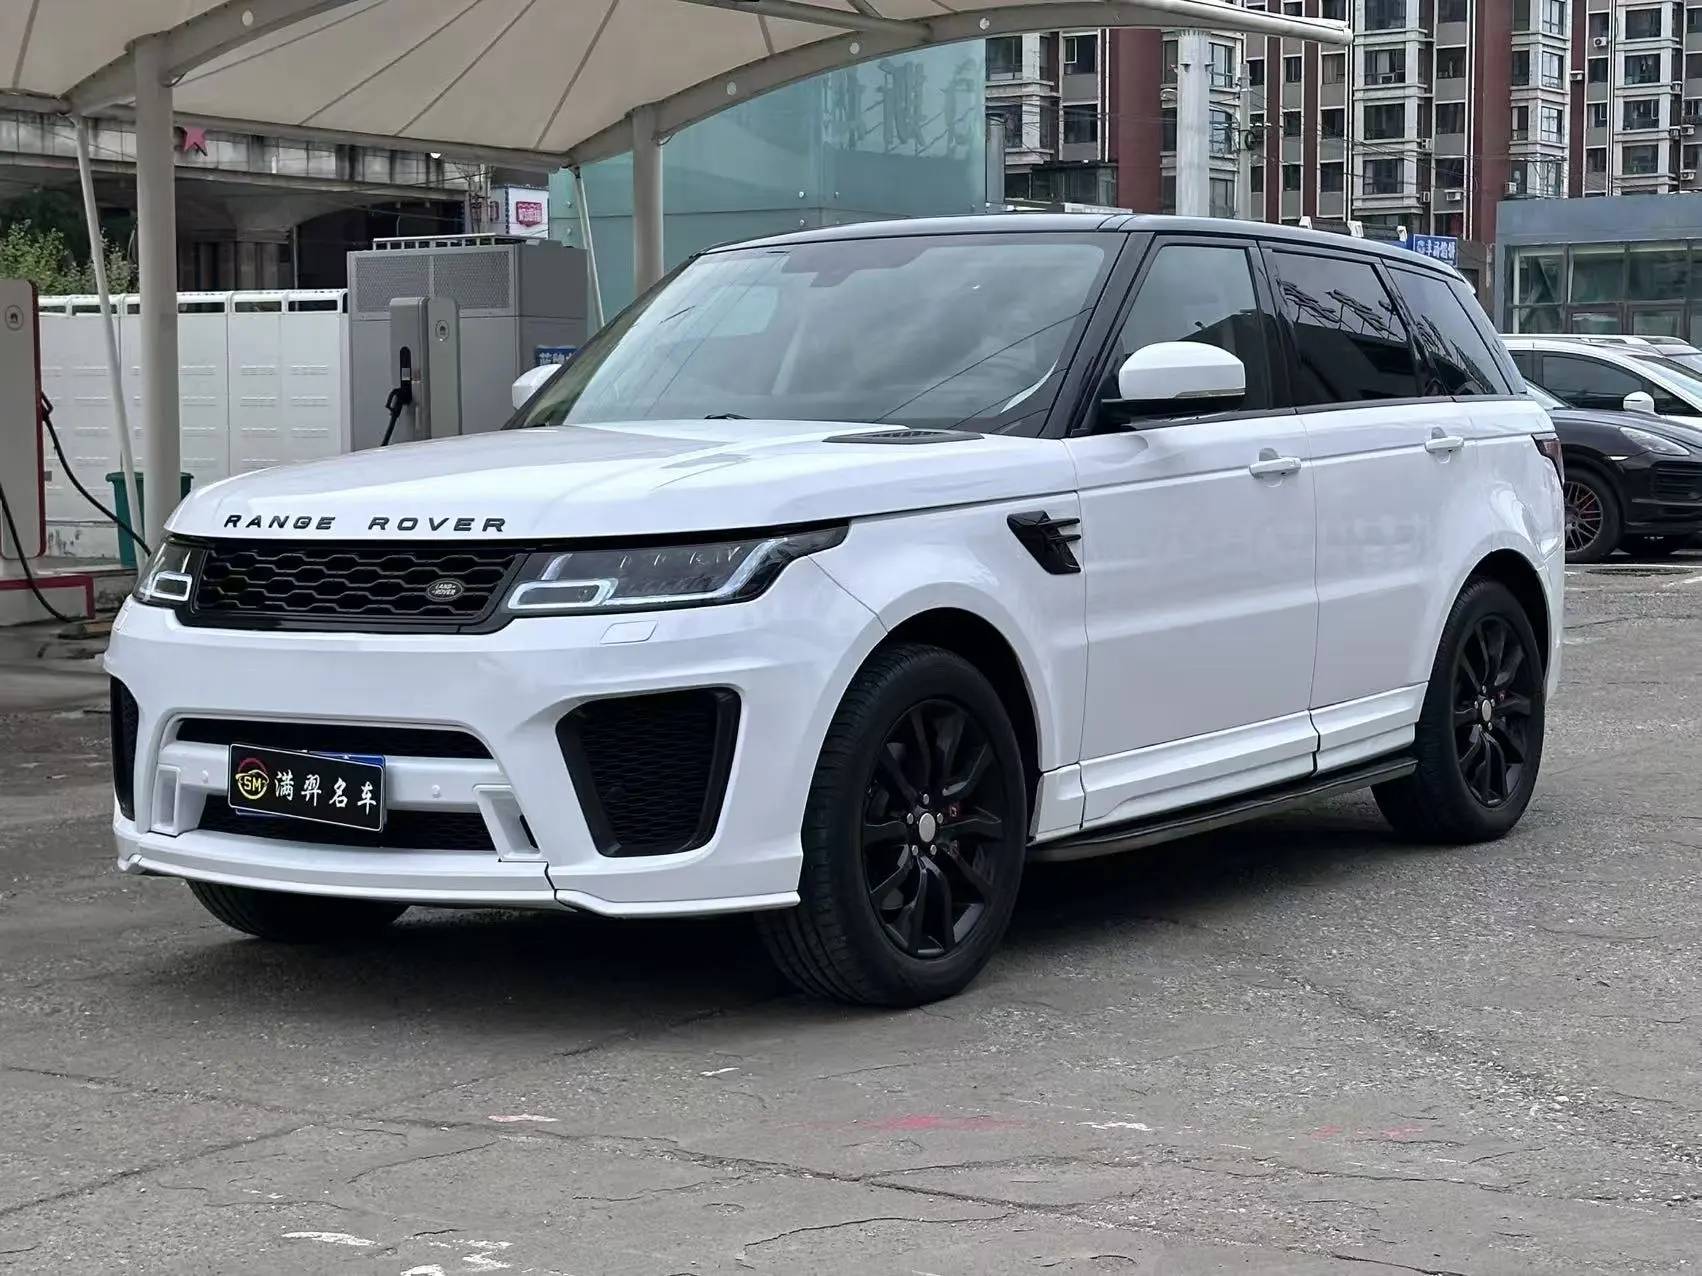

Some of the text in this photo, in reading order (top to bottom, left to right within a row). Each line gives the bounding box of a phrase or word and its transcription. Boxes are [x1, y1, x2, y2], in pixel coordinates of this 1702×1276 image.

[223, 514, 507, 533] RANGE ROVER
[243, 776, 262, 792] SM
[274, 768, 377, 816] 满羿名车
